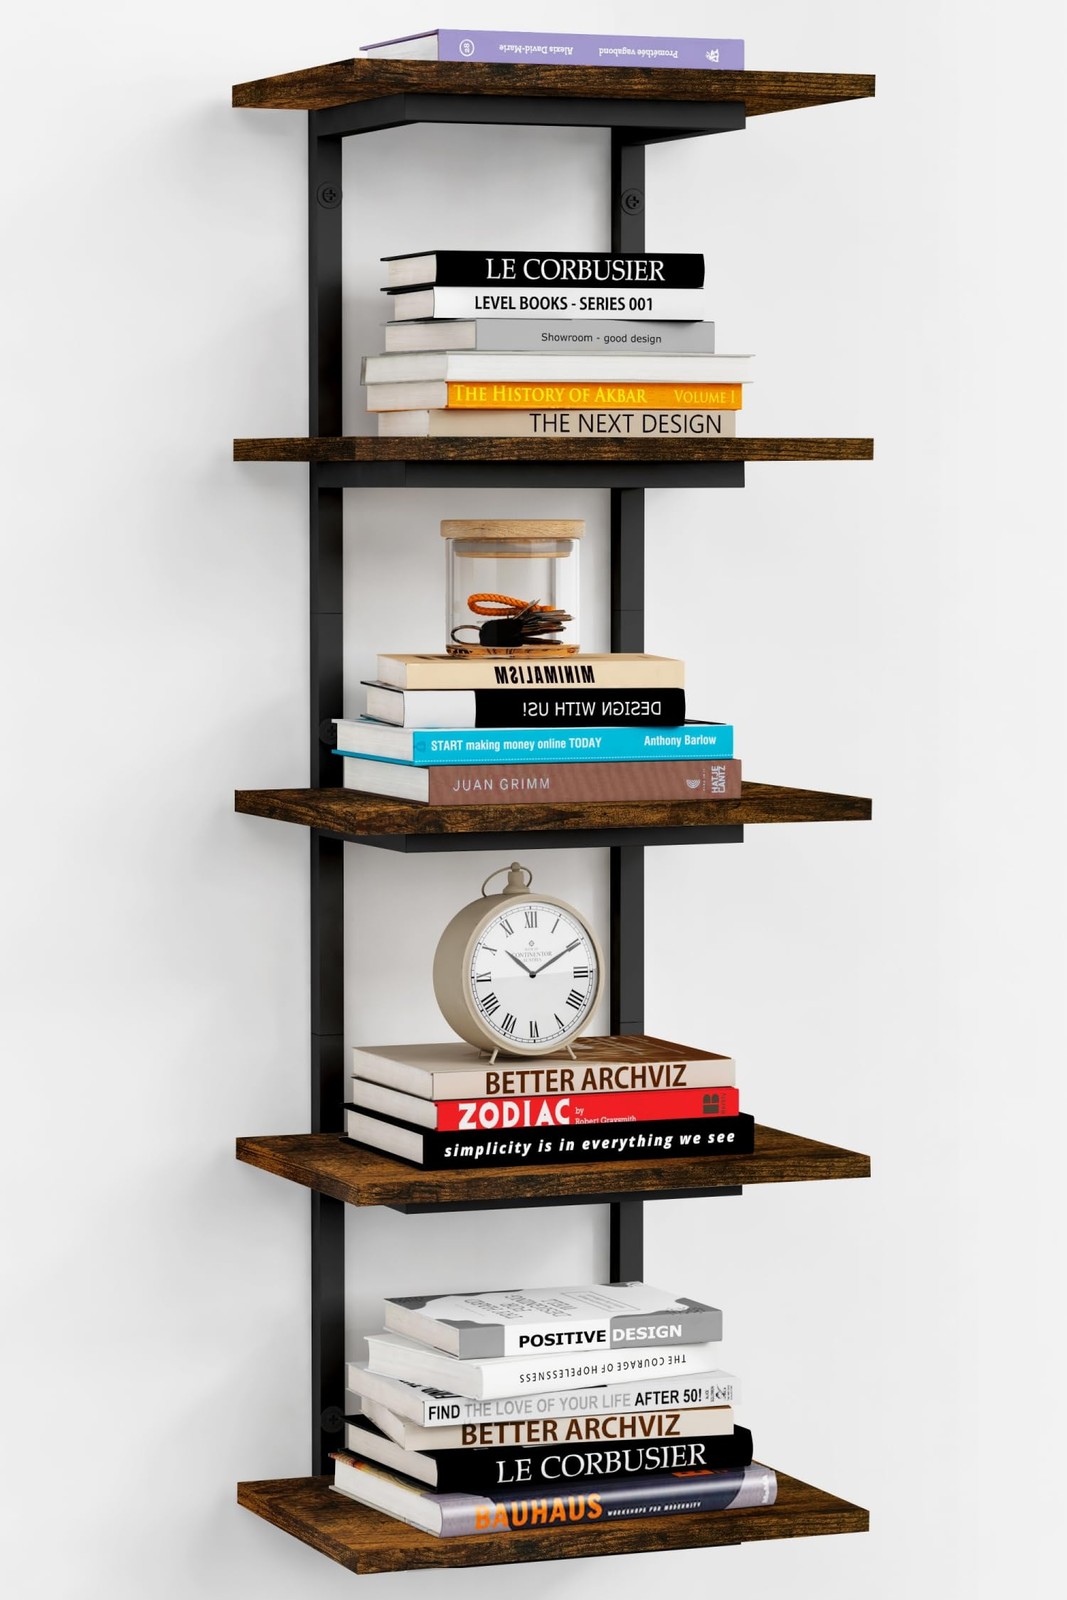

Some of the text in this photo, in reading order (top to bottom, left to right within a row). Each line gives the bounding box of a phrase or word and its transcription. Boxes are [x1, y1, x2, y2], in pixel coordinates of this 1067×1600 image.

[499, 45, 573, 55] Alexis David-Marie
[599, 47, 678, 58] Prométhée vagabond
[486, 259, 665, 281] LE CORBUSIER
[476, 296, 516, 309] LEVEL
[520, 297, 567, 310] BOOKS
[580, 297, 625, 310] SERIES
[629, 298, 652, 310] 001
[542, 333, 592, 342] Showroom
[604, 335, 627, 344] good
[631, 335, 661, 345] design
[529, 414, 720, 433] THE NEXT DESIGN
[431, 737, 601, 752] START making money online TODAY
[644, 735, 716, 747] Anthony Barlow
[453, 778, 549, 791] JUAN GRIMM
[718, 764, 726, 794] CANTZ
[486, 1064, 687, 1094] BETTER ARCHVIZ
[458, 1098, 570, 1129] ZODIAC
[576, 1107, 584, 1116] by
[444, 1132, 734, 1159] simplicity is in everything we see
[520, 1324, 683, 1348] POSITIVE DESIGN
[520, 1355, 686, 1383] THE COURAGE OF HOPELESSNESS
[429, 1405, 460, 1420] FIND
[464, 1402, 492, 1418] THE
[496, 1399, 533, 1416] LOVE
[537, 1399, 556, 1412] OF
[559, 1395, 598, 1411] YOUR
[602, 1393, 631, 1408] LIFE
[635, 1390, 679, 1406] AFTER
[684, 1389, 701, 1402] 50!
[462, 1414, 681, 1445] BETTER ARCHVIZ
[496, 1442, 706, 1483] LE CORBUSIER
[475, 1494, 603, 1530] BAUHAUS
[608, 1507, 646, 1516] WORKSHOPS
[664, 1502, 701, 1510] MODERNITY
